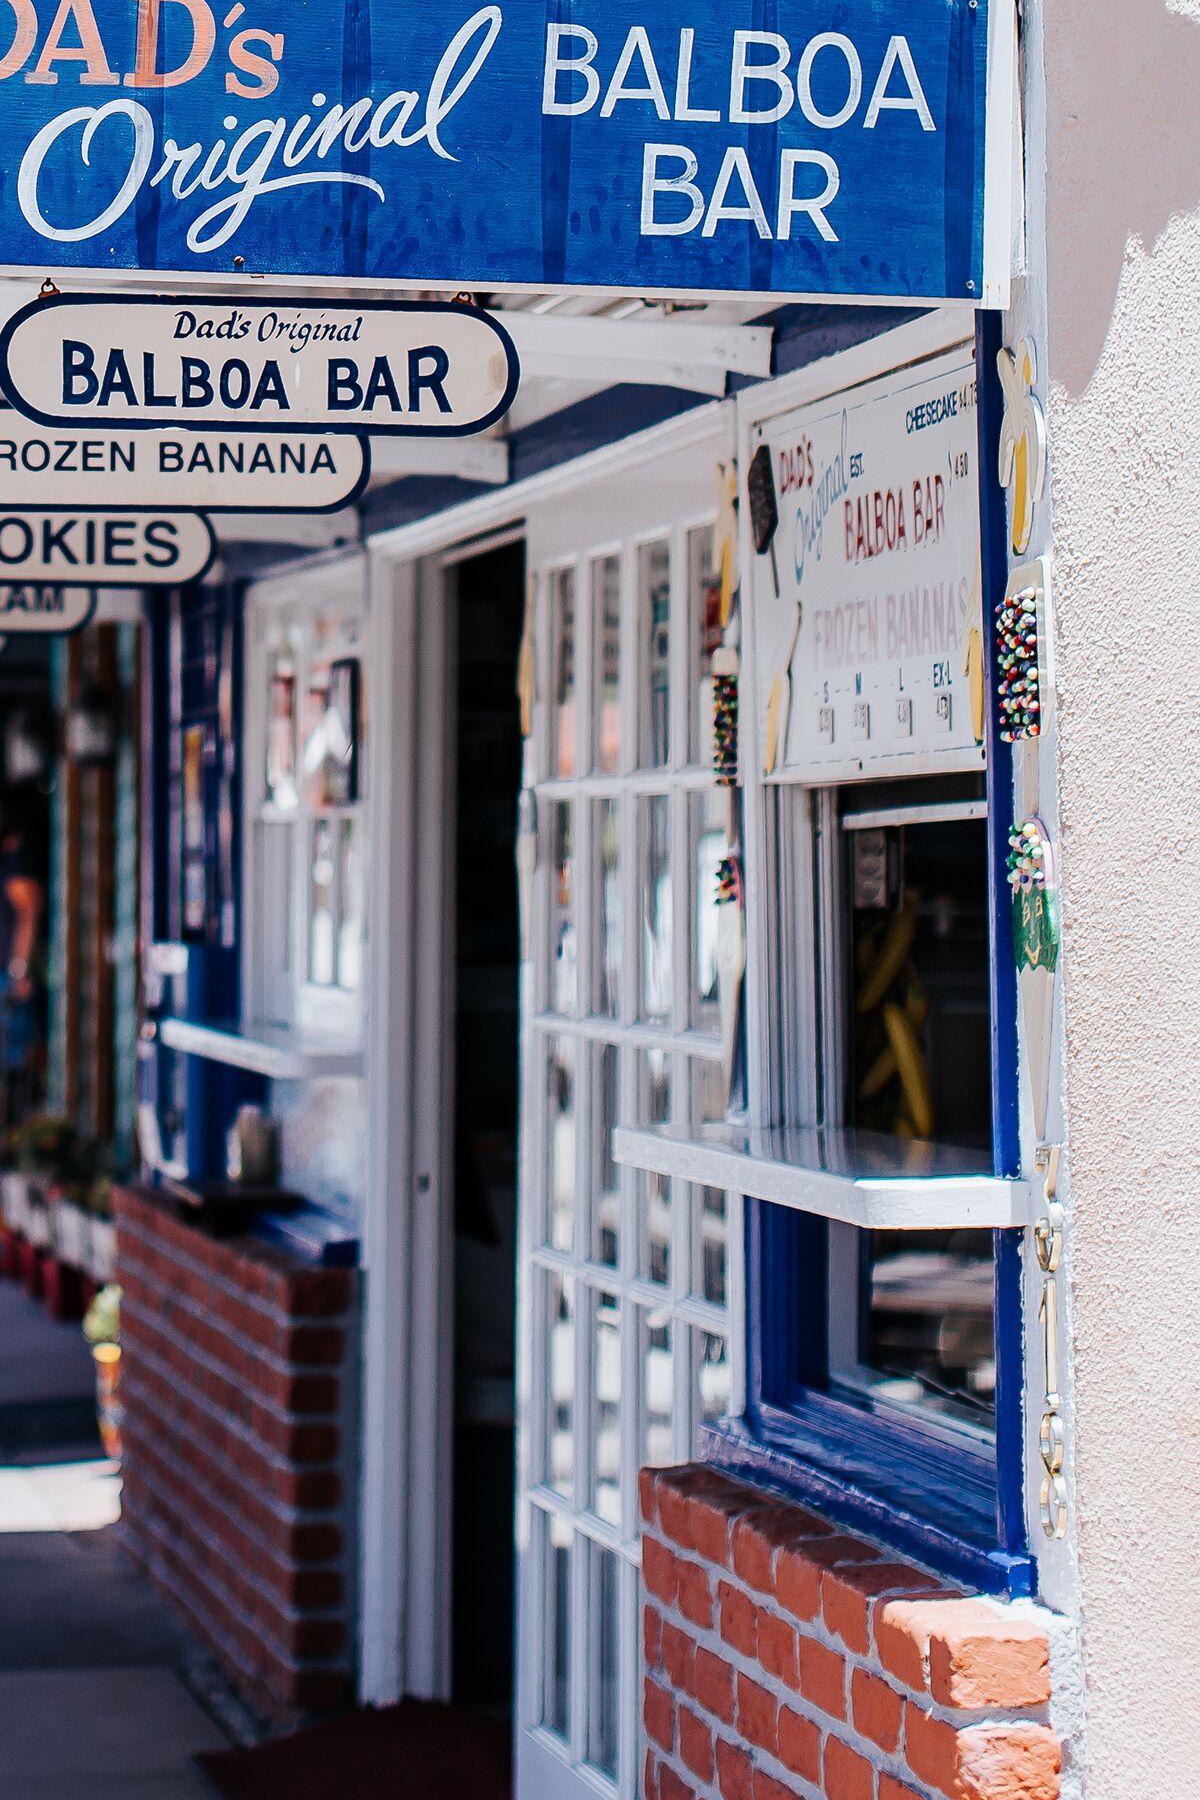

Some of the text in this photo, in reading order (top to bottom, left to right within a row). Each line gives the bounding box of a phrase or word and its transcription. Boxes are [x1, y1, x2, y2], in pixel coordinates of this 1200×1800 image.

[541, 22, 937, 132] BALBOA
[17, 5, 502, 253] Original
[640, 143, 841, 243] BAR
[172, 309, 364, 354] Dad's Original
[62, 338, 453, 414] BALBOA BAR
[905, 390, 958, 434] CHEESECAKE
[157, 440, 338, 476] BANANA
[844, 474, 946, 563] BALBOA BAR
